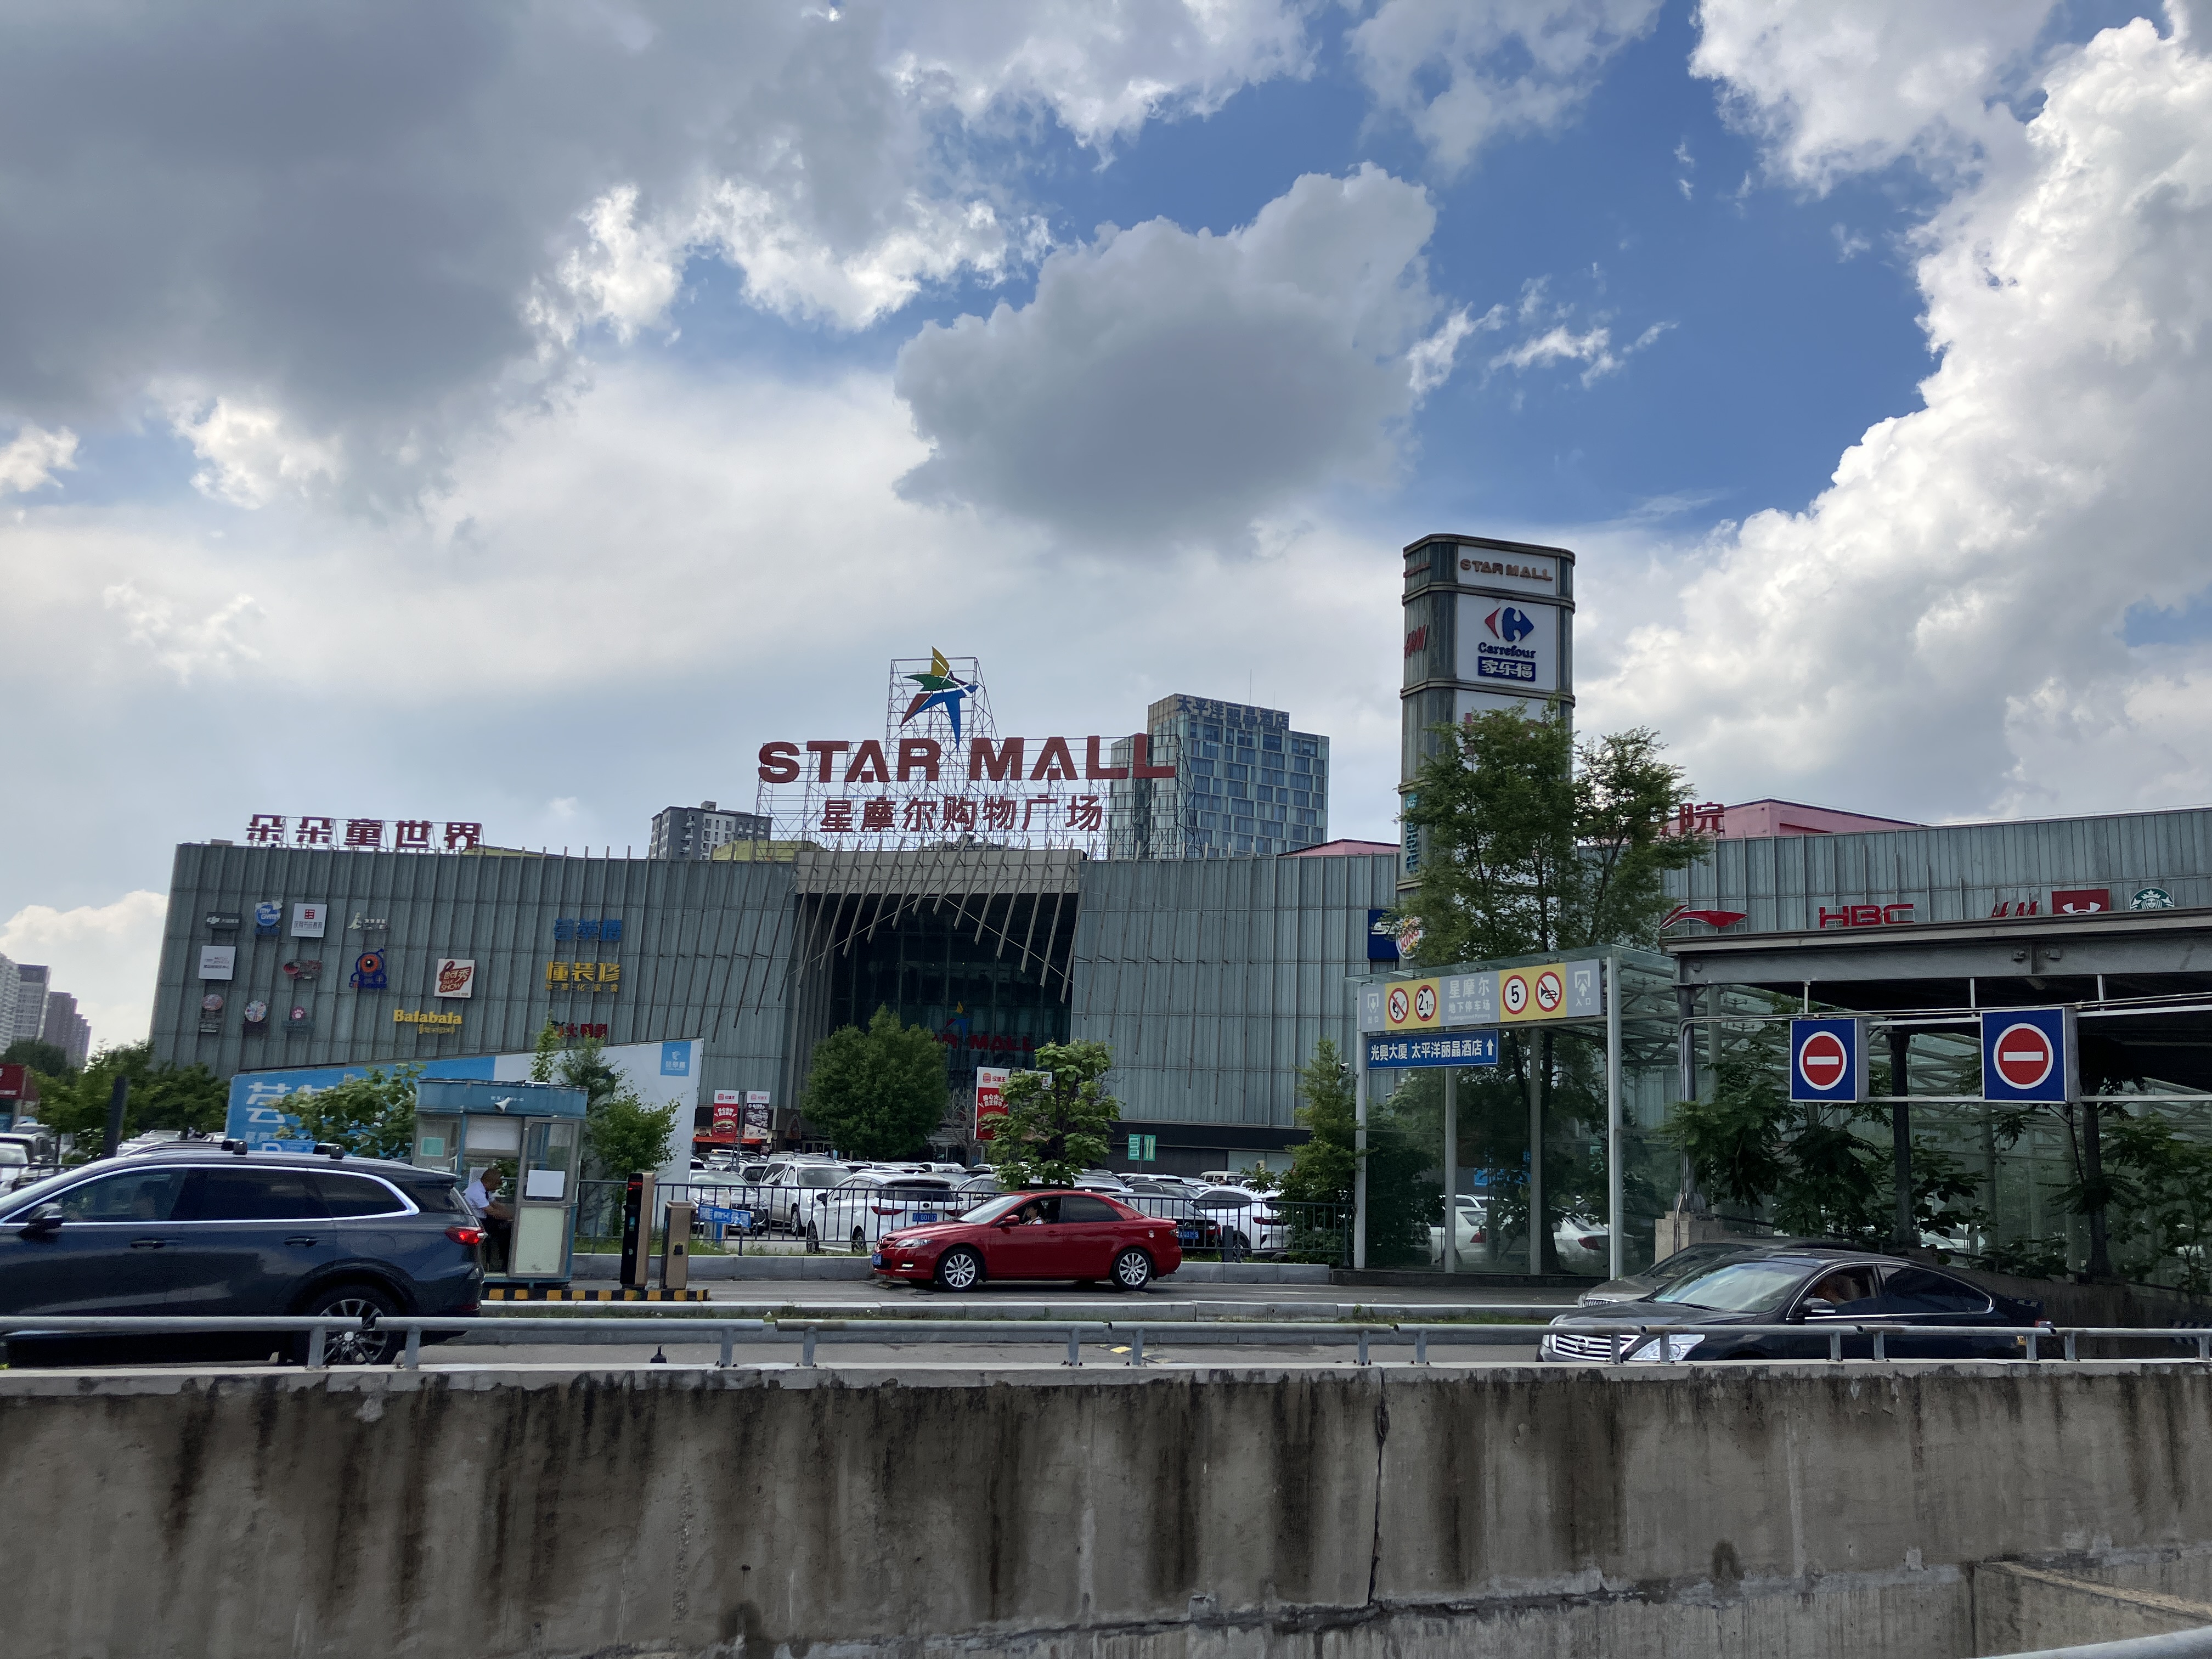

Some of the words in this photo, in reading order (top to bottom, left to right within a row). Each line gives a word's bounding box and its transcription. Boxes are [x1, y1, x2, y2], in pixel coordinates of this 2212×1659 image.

[1460, 558, 1503, 575] STAR
[1506, 563, 1554, 582] MALL
[1478, 642, 1537, 659] Carrefour
[1481, 660, 1533, 678] 家乐福
[1176, 696, 1289, 729] 太平洋丽晶酒店
[758, 738, 941, 783] STAR
[969, 733, 1176, 781] MALL
[820, 794, 1104, 832] 星摩尔购物广场
[246, 814, 481, 850] 朵朵童世界
[1819, 904, 1915, 928] HBC
[546, 961, 620, 982] 懂装修
[441, 983, 462, 991] SHOW
[1449, 977, 1490, 999] 星摩尔
[1510, 984, 1520, 1004] 5
[1448, 999, 1491, 1013] 地下停车场
[1576, 997, 1592, 1008] 入口
[393, 1009, 462, 1024] Balabala
[969, 1034, 1036, 1052] MALL
[1412, 1039, 1482, 1059] 太平洋丽晶酒店
